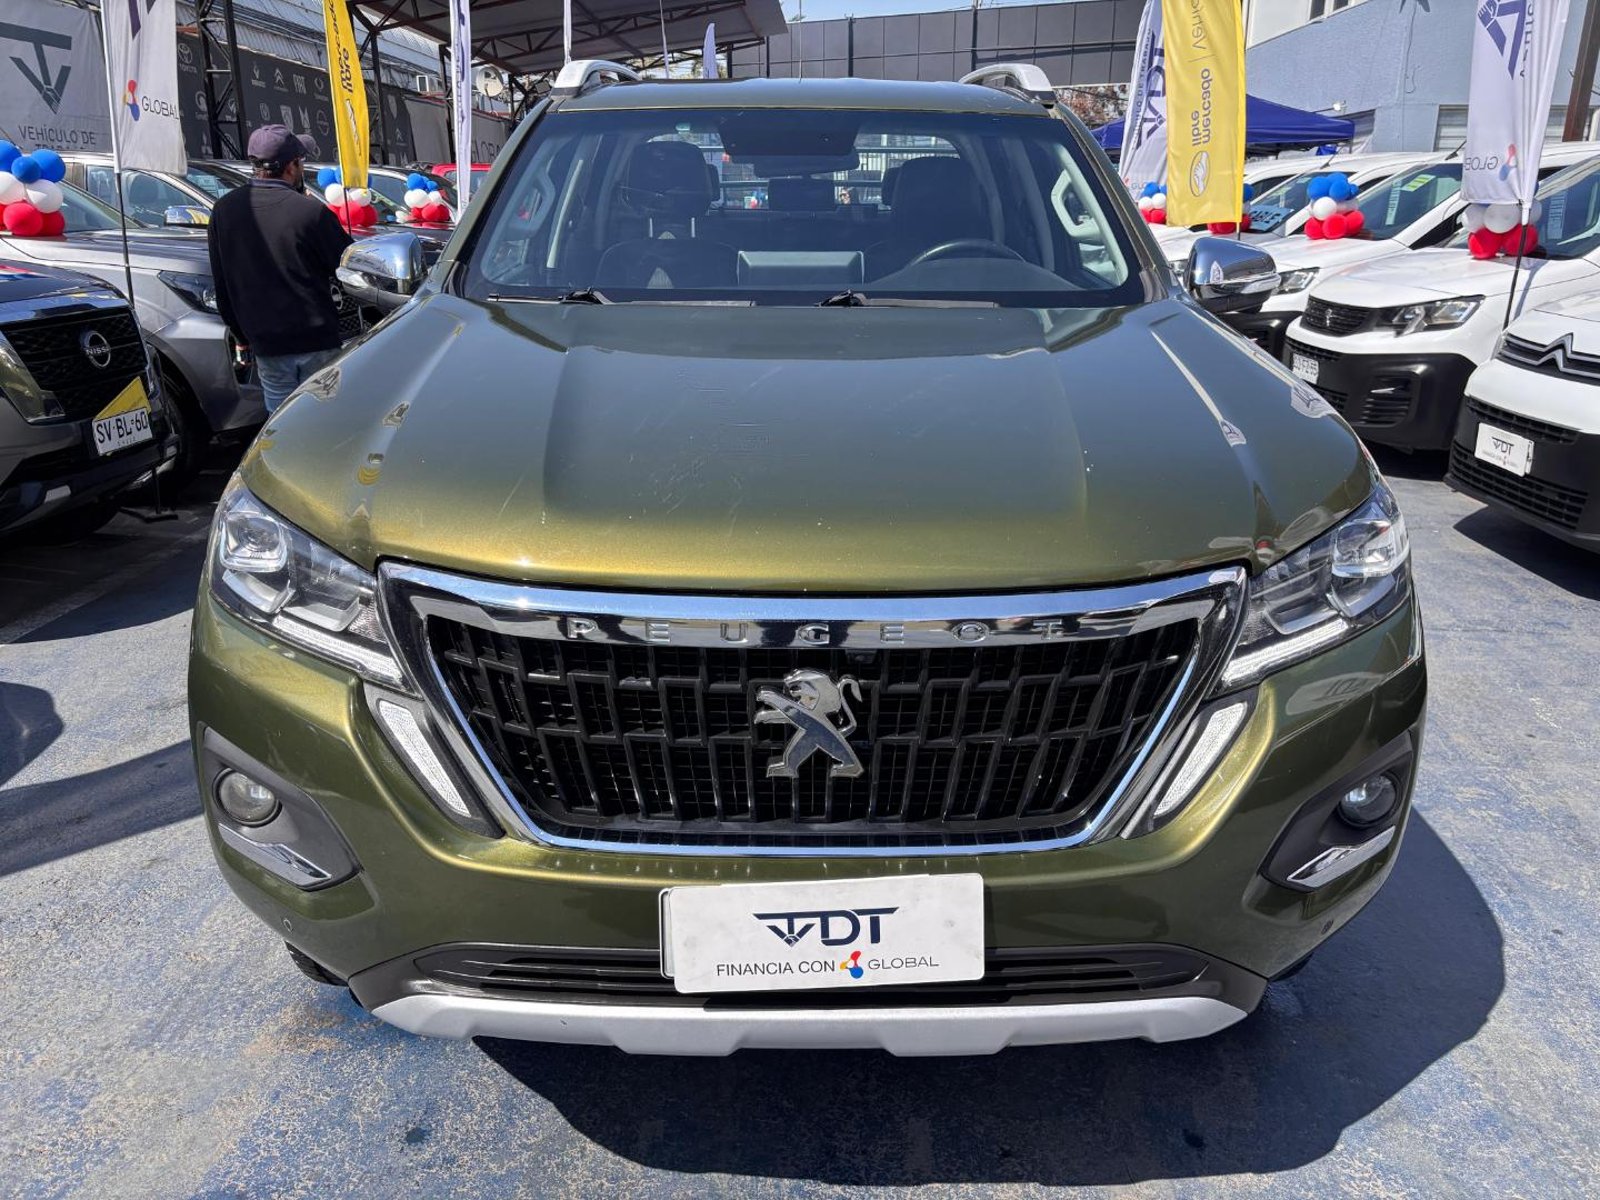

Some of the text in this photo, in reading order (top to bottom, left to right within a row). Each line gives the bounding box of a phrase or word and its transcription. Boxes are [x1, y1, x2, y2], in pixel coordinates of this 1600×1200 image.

[141, 95, 180, 120] GLOBAL
[81, 131, 97, 145] DE
[566, 617, 1065, 646] PEUGEOT
[716, 955, 940, 977] FINANCIA CON GLOBAL
